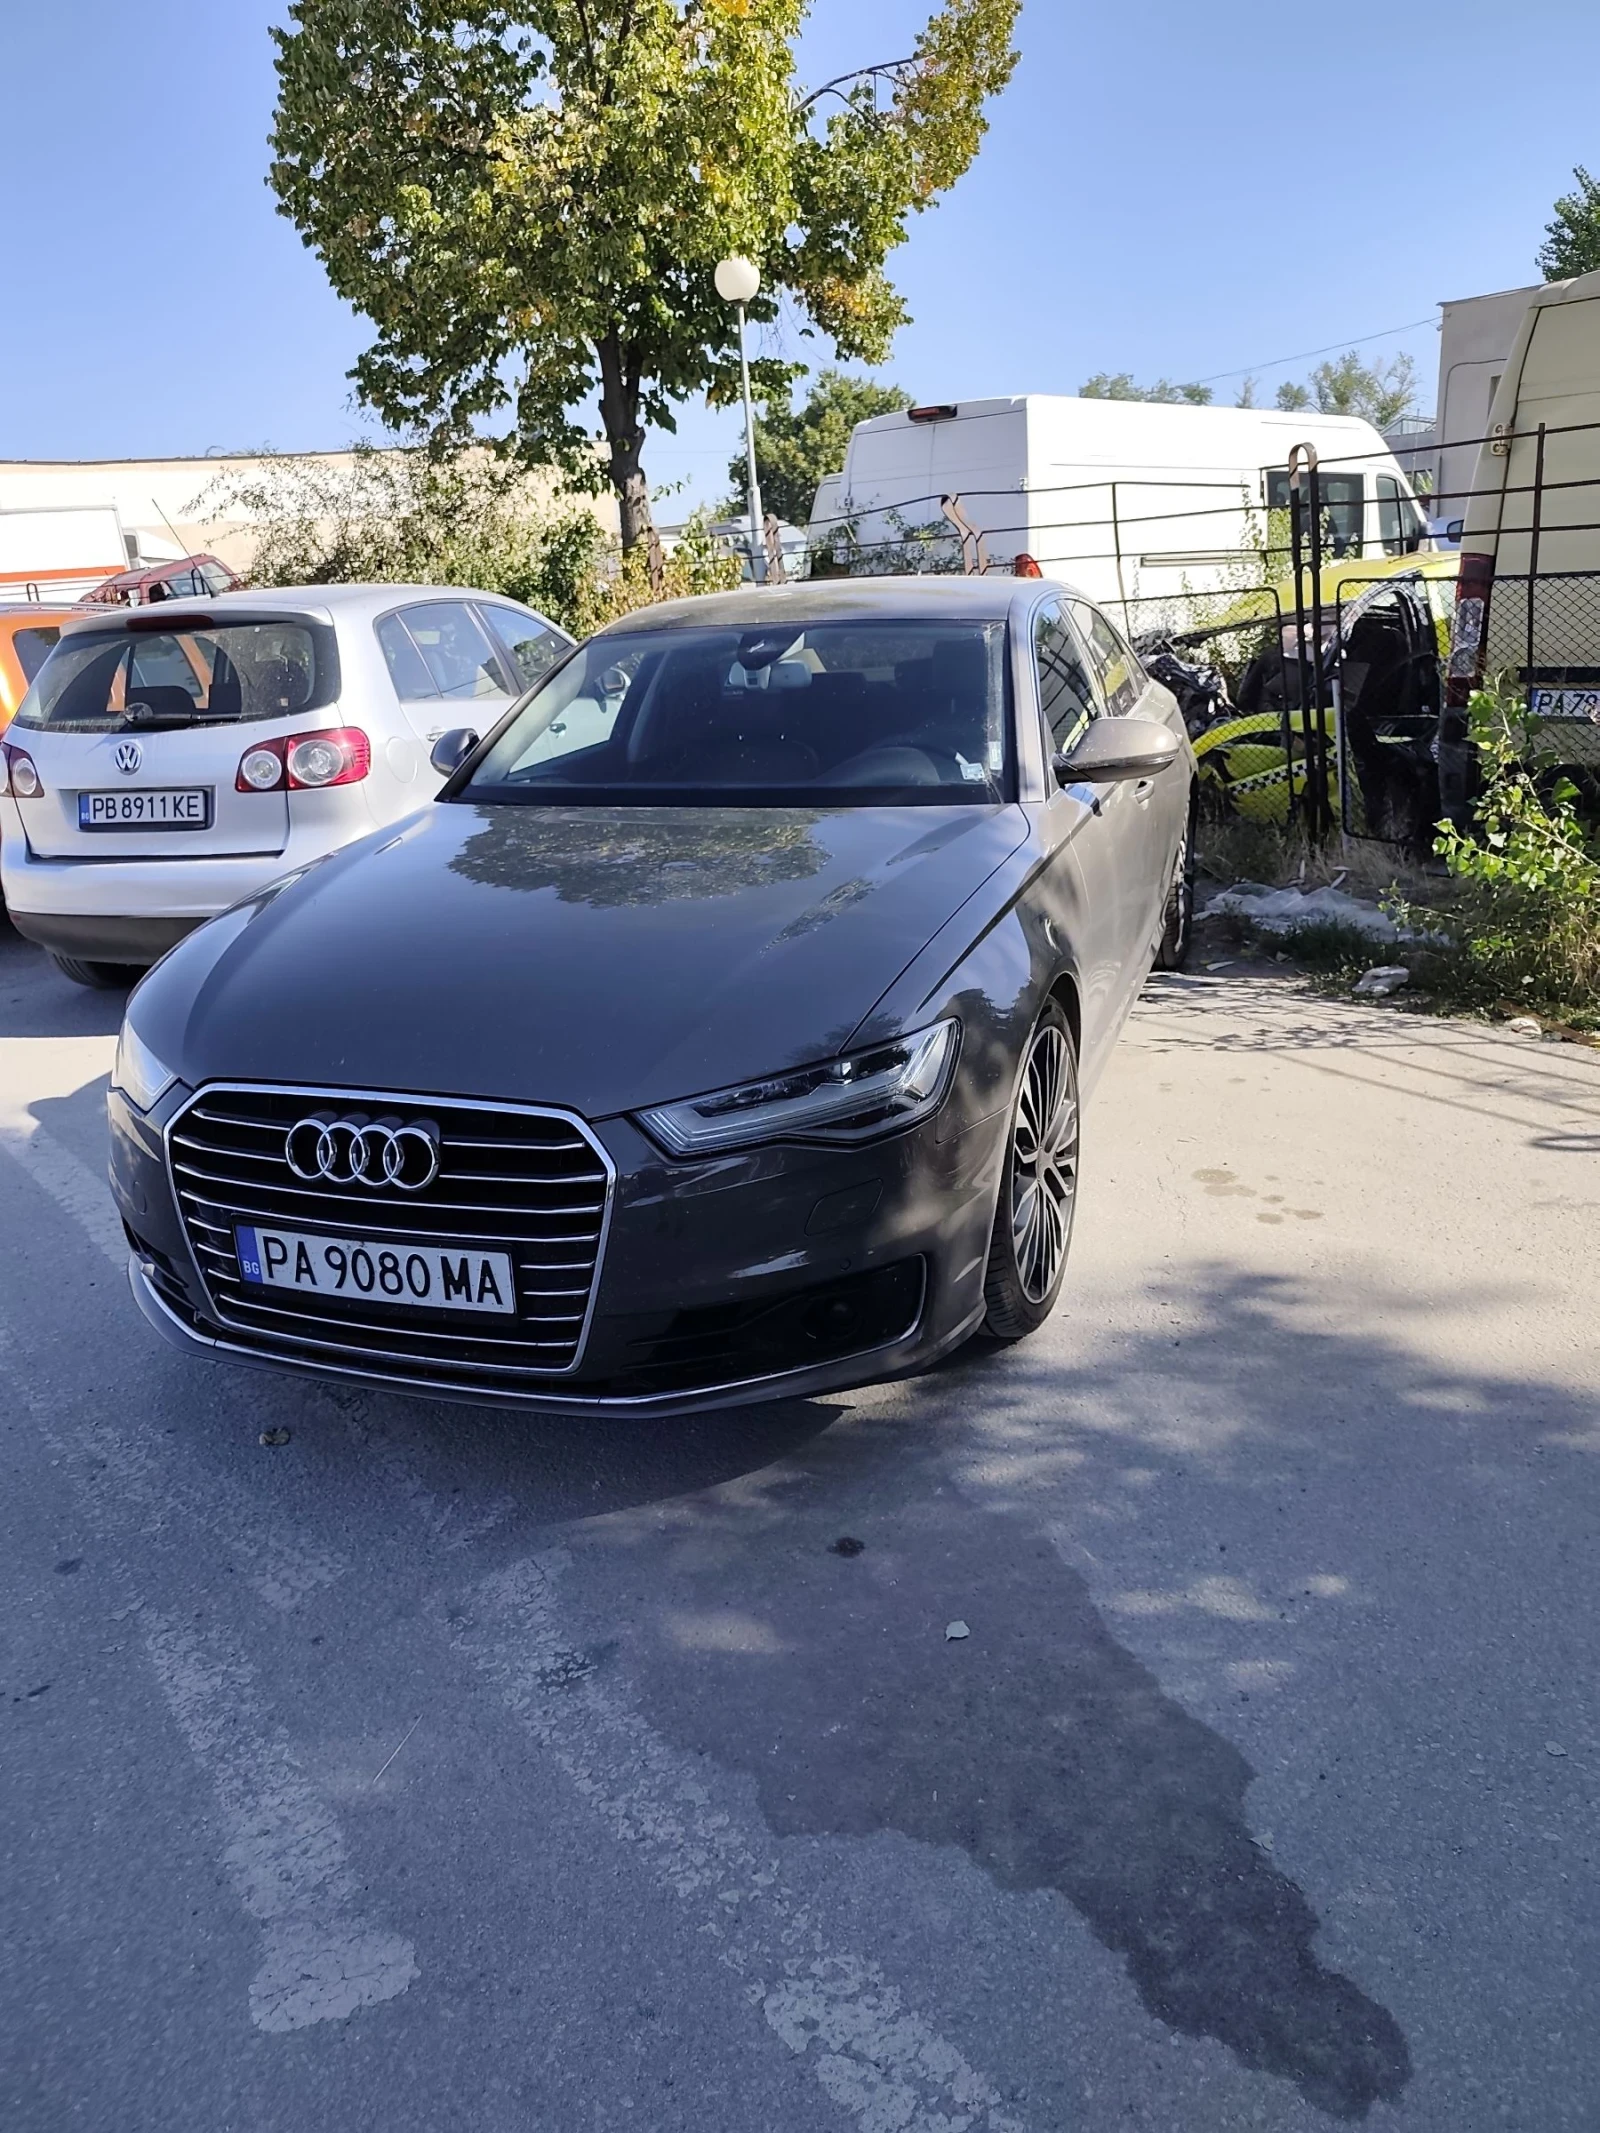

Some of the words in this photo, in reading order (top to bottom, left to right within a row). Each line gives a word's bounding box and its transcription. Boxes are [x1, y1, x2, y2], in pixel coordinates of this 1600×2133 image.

[1537, 693, 1564, 713] PA
[93, 797, 117, 819] PB
[121, 796, 166, 819] 8911
[173, 795, 199, 818] KE
[242, 1259, 260, 1275] BG
[262, 1235, 318, 1286] PA
[323, 1245, 431, 1298] 9080
[440, 1255, 504, 1305] MA
